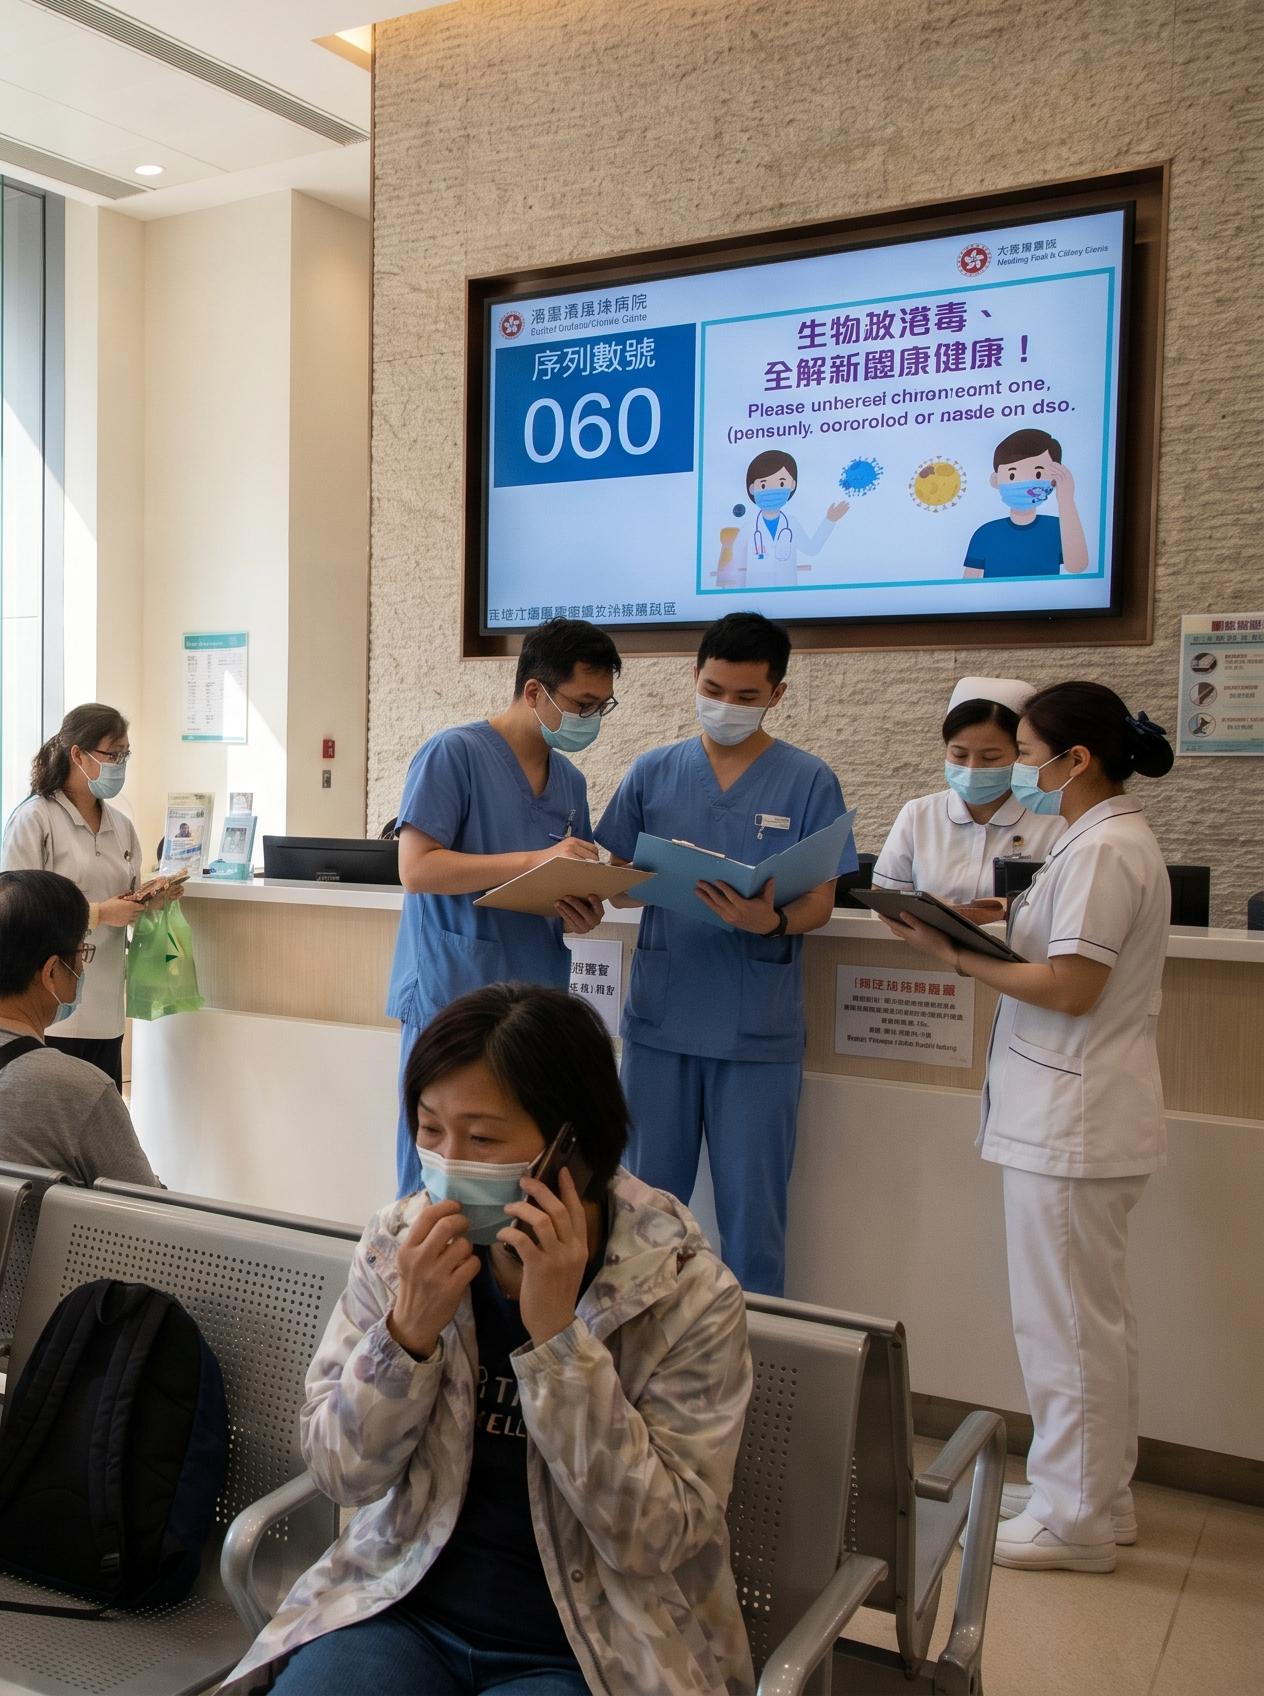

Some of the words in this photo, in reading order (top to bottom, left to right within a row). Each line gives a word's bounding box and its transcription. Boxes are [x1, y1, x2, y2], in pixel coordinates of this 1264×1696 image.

[532, 337, 656, 381] 序列數號
[748, 400, 805, 419] Please
[1008, 378, 1052, 394] one,
[914, 410, 935, 425] or
[1001, 402, 1026, 418] on
[524, 387, 661, 464] 060
